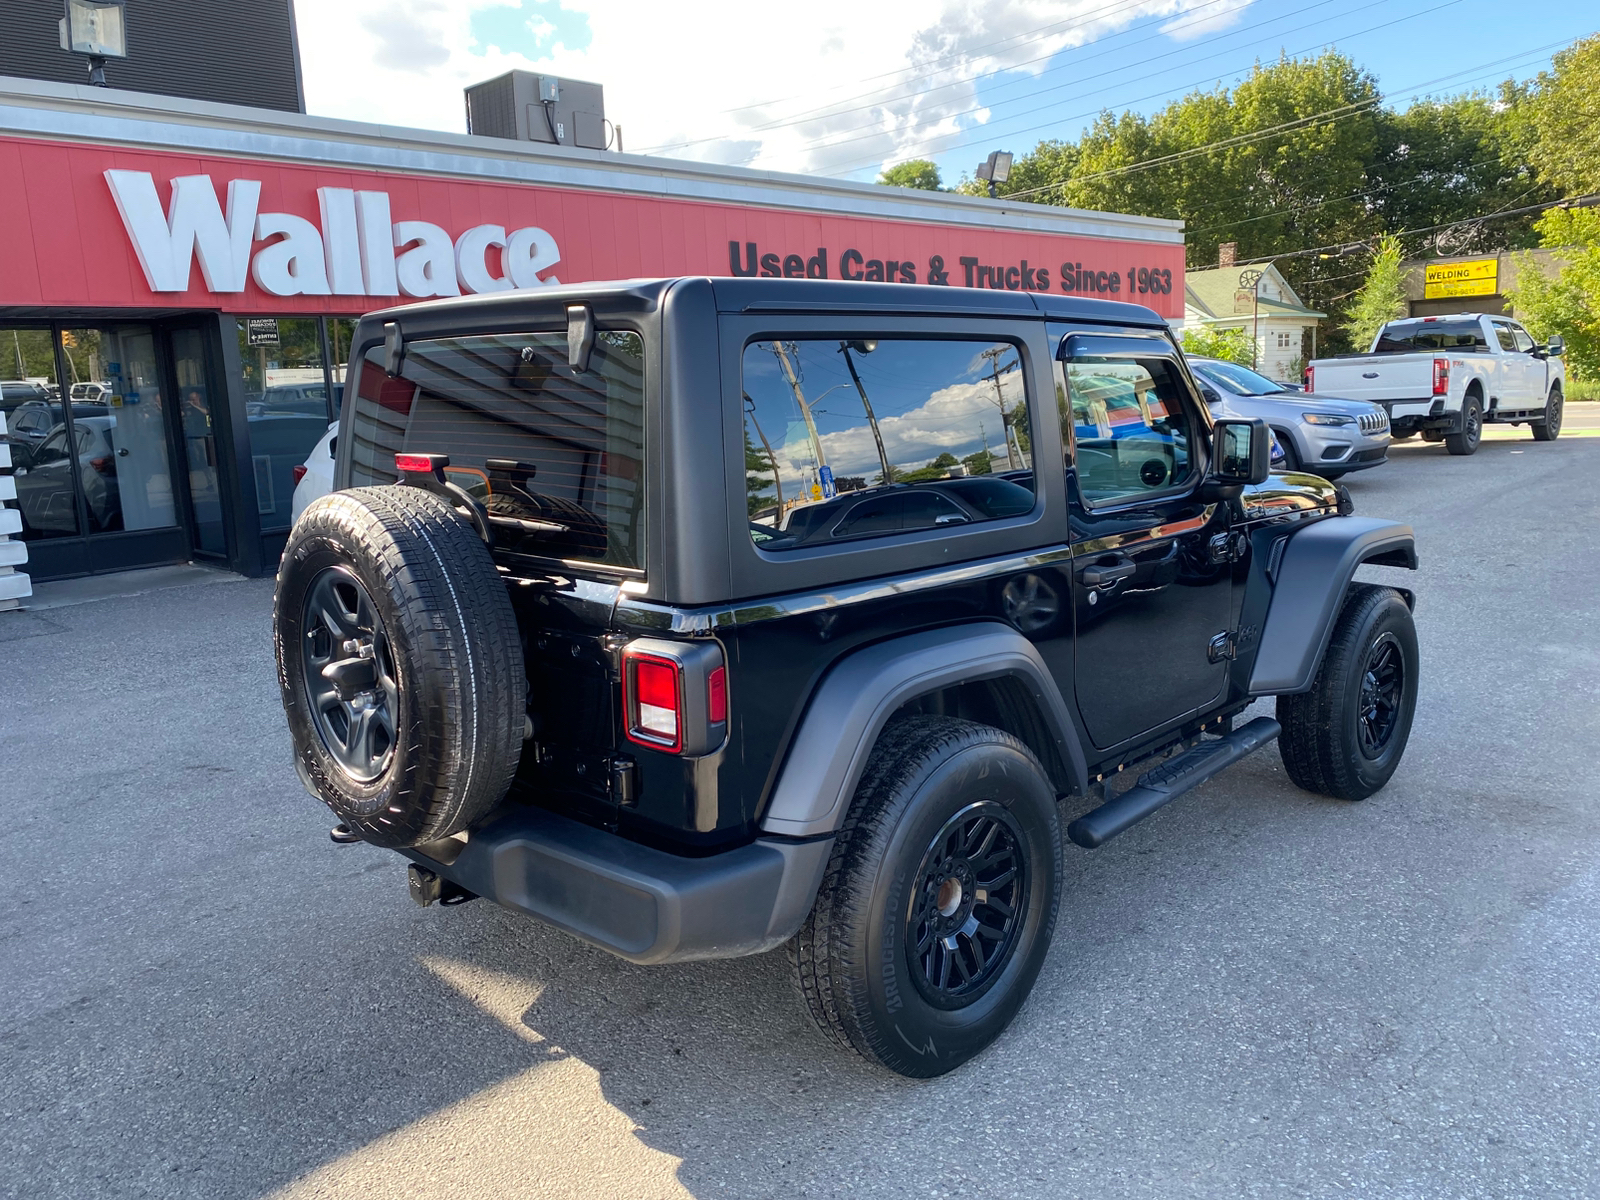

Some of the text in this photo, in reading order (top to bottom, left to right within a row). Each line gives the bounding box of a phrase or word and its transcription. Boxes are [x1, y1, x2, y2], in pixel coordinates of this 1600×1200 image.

[103, 169, 561, 297] Wallace
[728, 240, 1172, 295] Used Cars & Trucks Since 1963
[1428, 269, 1470, 280] WELDING
[882, 870, 906, 1014] BRIDGESTONE
